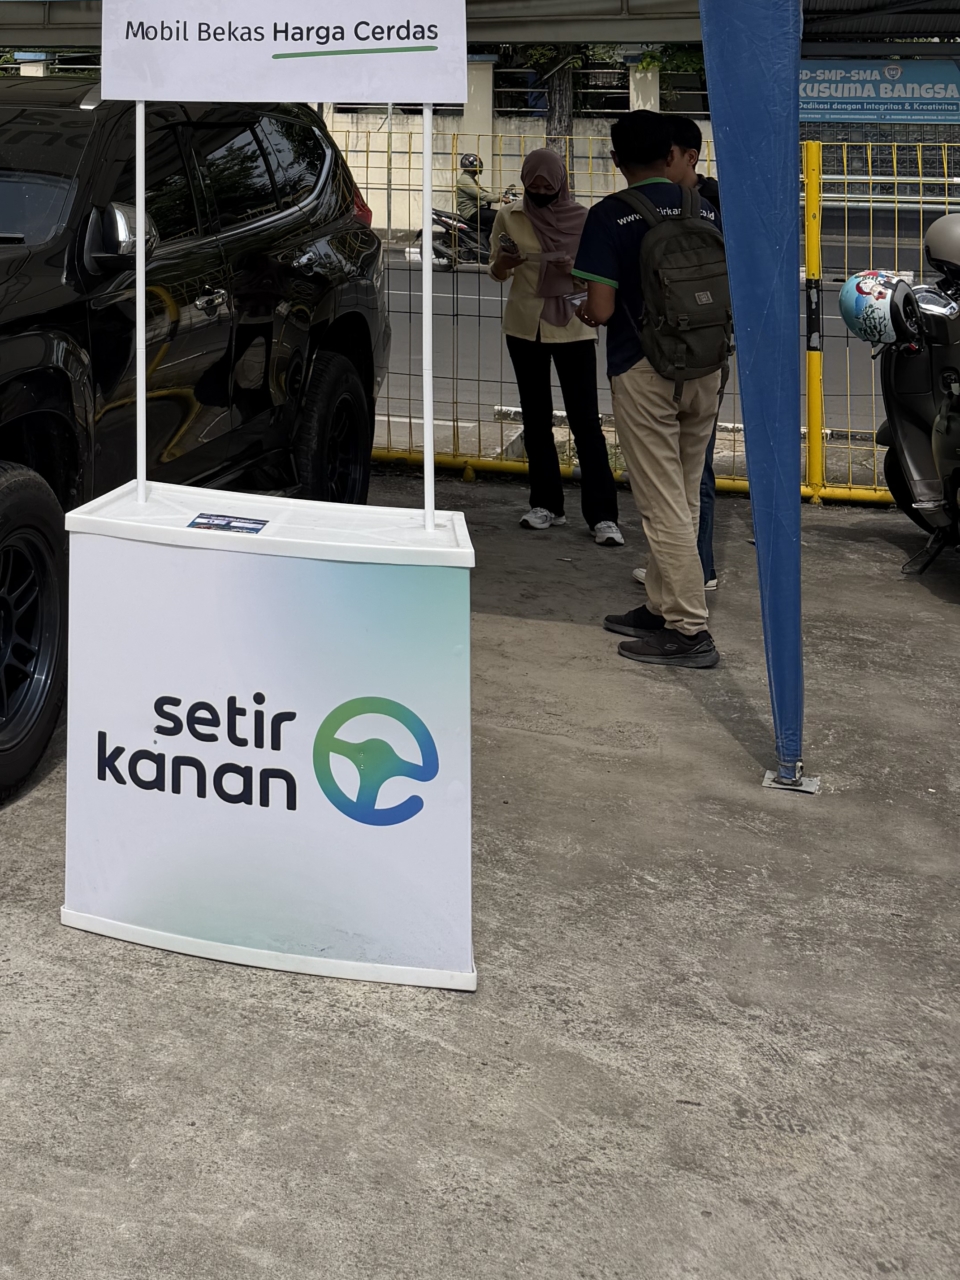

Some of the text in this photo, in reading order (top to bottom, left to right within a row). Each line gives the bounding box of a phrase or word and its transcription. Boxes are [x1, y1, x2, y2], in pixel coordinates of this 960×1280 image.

[124, 20, 438, 45] Mobil Bekas Harga Cerdas
[799, 83, 959, 98] KUSUMA BANGSA
[832, 102, 862, 111] dengan
[863, 103, 902, 111] Integritas
[913, 103, 957, 111] Kreativitas
[153, 691, 297, 751] setir
[97, 730, 297, 811] kanan
